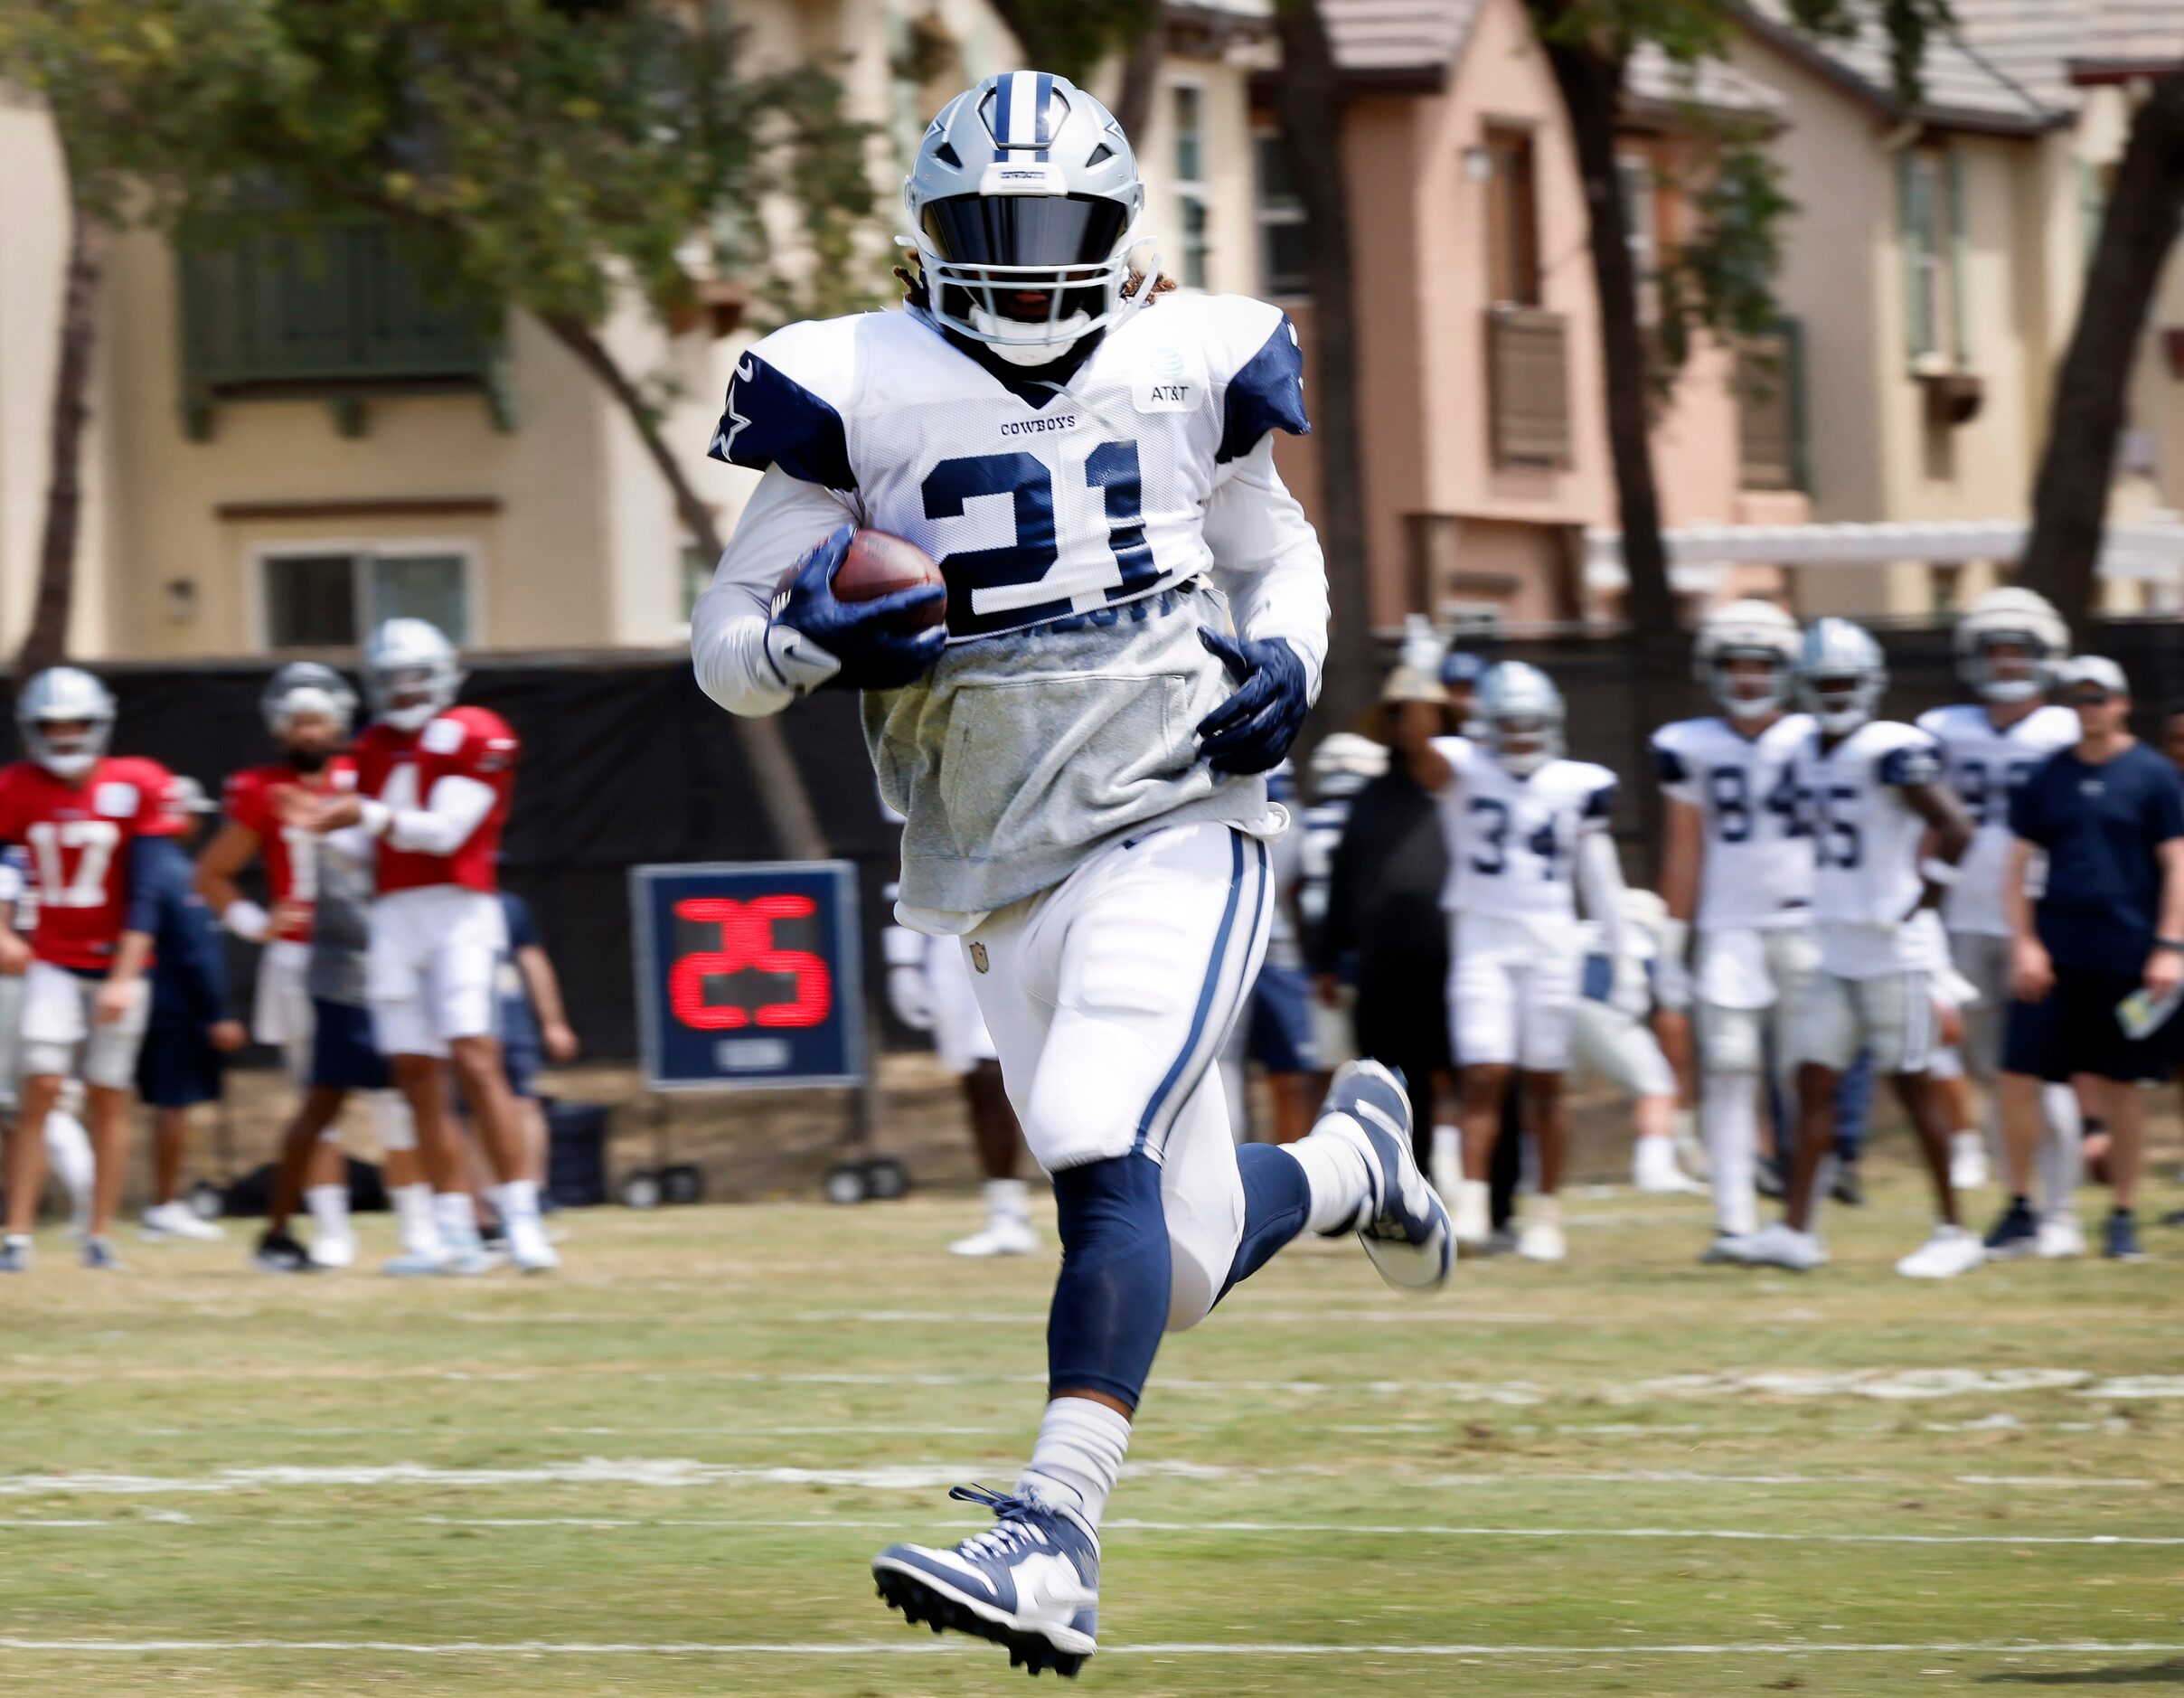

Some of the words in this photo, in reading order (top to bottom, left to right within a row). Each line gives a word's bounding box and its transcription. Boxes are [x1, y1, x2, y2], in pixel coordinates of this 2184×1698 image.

[1001, 415, 1076, 436] COWBOYS
[1151, 386, 1190, 402] AT&T
[921, 439, 1173, 638] 21
[26, 819, 121, 908] 17
[668, 893, 832, 1030] 25
